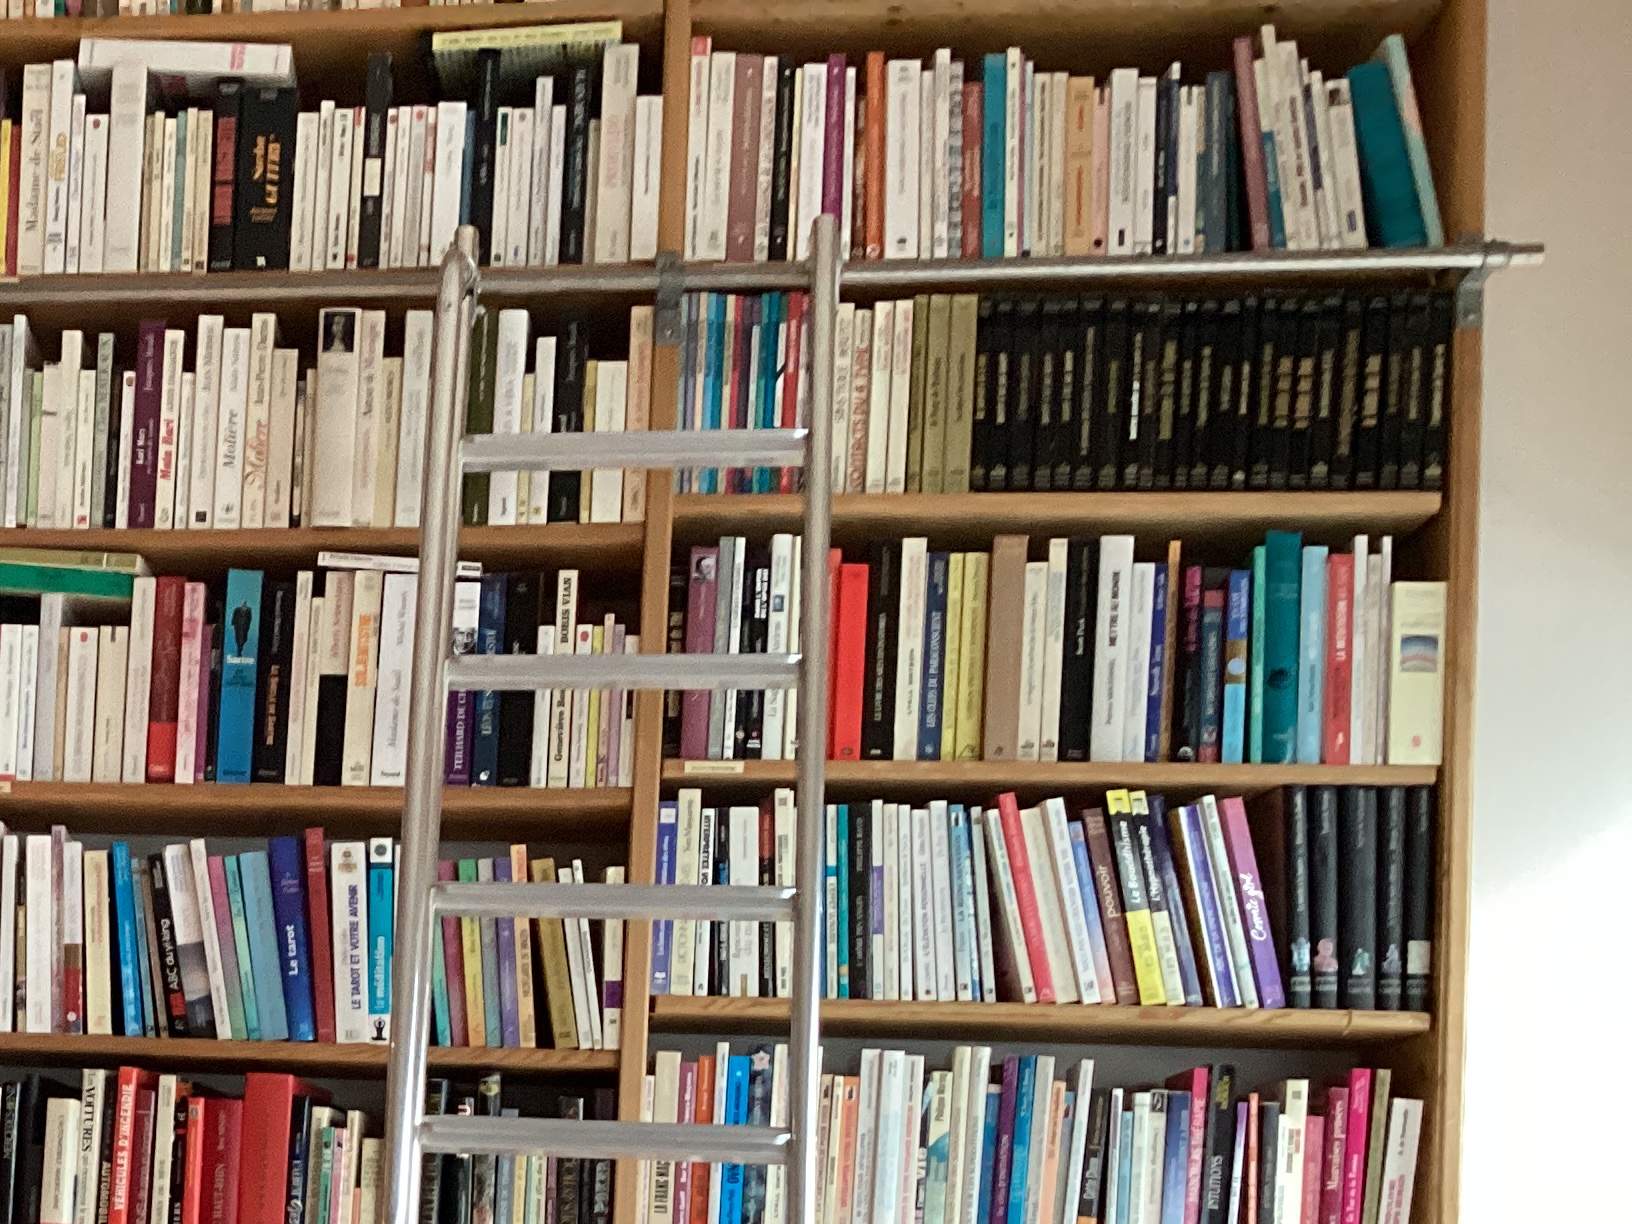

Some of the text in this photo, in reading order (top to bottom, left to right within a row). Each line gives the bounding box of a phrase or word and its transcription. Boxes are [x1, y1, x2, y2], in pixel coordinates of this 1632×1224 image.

[559, 577, 572, 644] BORIS VIAN
[1097, 864, 1121, 918] pouvoir
[1117, 820, 1143, 904] Le Bouddhisme
[1239, 872, 1268, 942] Cosmic girl
[168, 966, 180, 990] ABC
[285, 925, 299, 976] Le tarot
[81, 1086, 97, 1152] VOITURES
[113, 1083, 133, 1211] VÉHICULES D'INCENDIE
[1207, 1154, 1224, 1210] INTUITIONS
